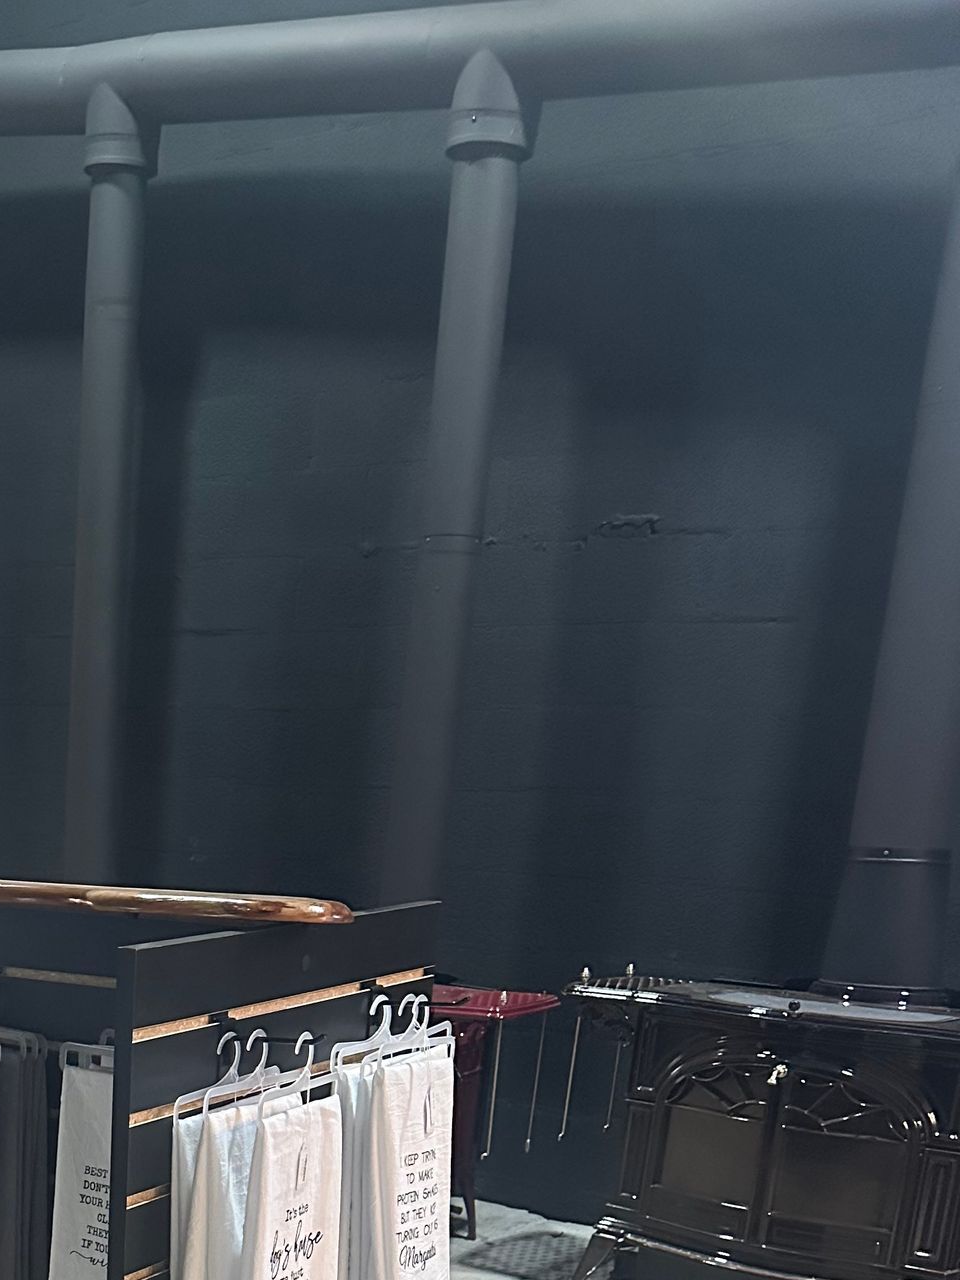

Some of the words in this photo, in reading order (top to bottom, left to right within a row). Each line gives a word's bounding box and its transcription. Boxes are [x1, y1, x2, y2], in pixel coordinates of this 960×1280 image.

[84, 1165, 109, 1179] BEST
[406, 1172, 415, 1184] TO
[83, 1180, 110, 1194] DON'T
[79, 1194, 104, 1208] YOUR
[81, 1238, 93, 1249] IF
